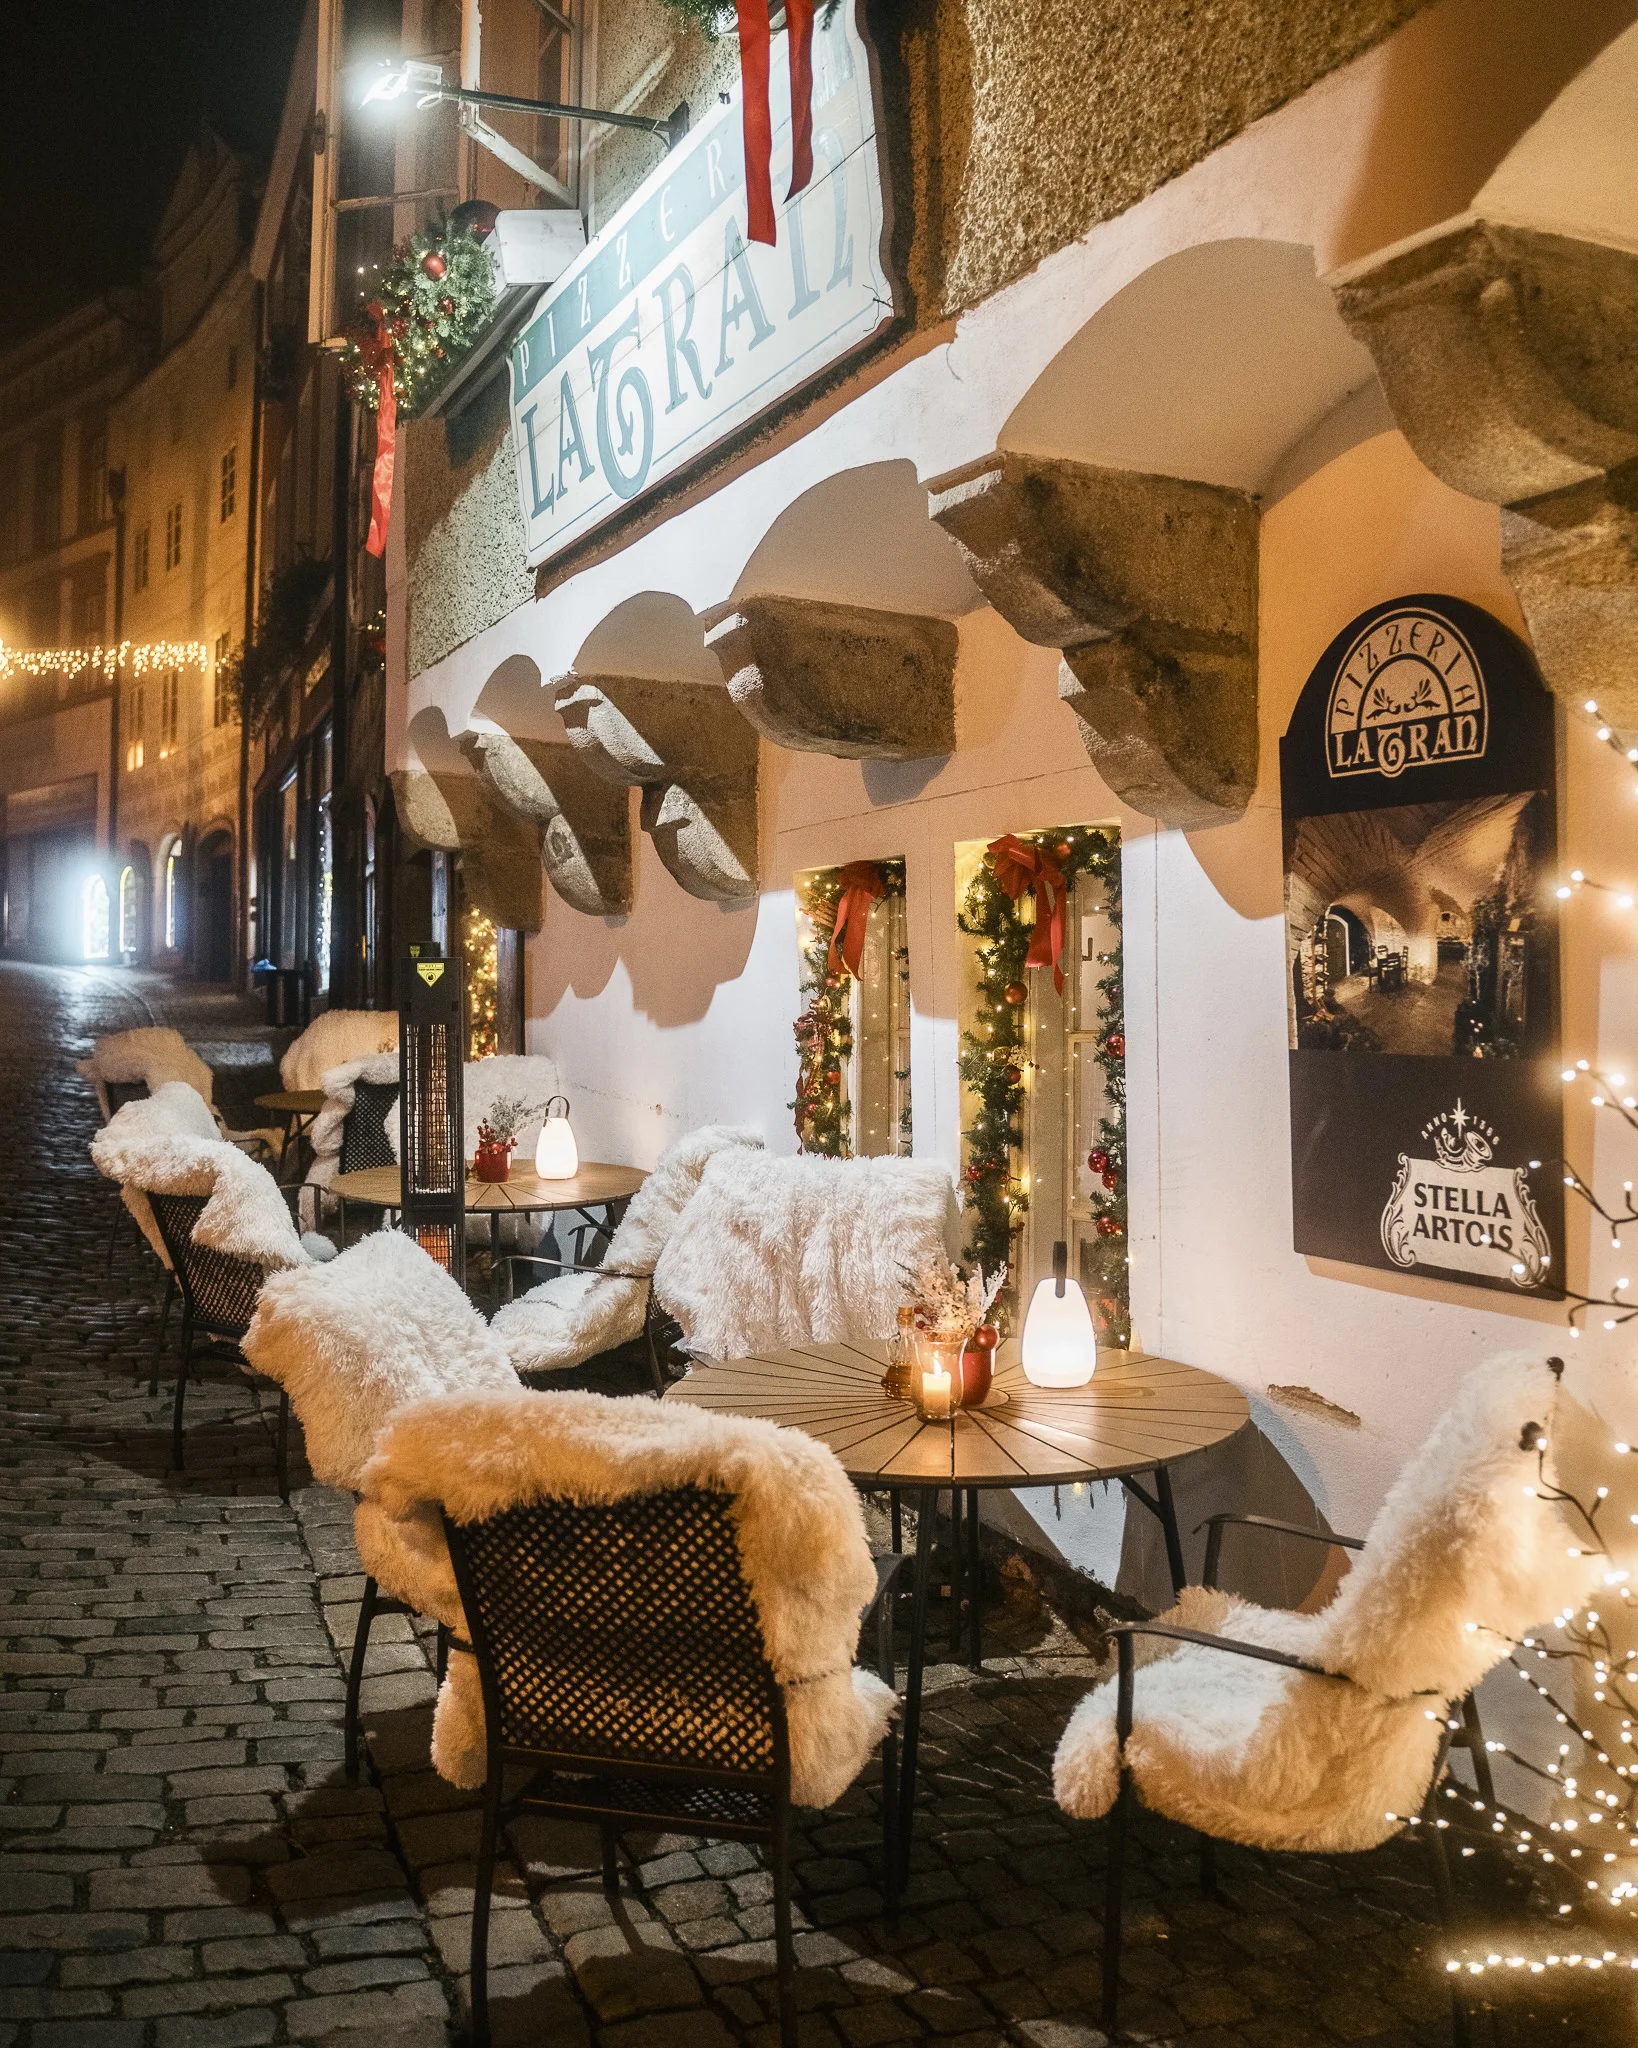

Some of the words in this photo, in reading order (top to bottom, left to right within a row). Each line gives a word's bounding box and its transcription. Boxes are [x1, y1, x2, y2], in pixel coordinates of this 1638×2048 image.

[1335, 621, 1476, 717] PIZZERIA
[1421, 1112, 1447, 1140] ANNO
[1413, 1182, 1512, 1220] STELLA
[1412, 1213, 1513, 1252] ARTOIS
